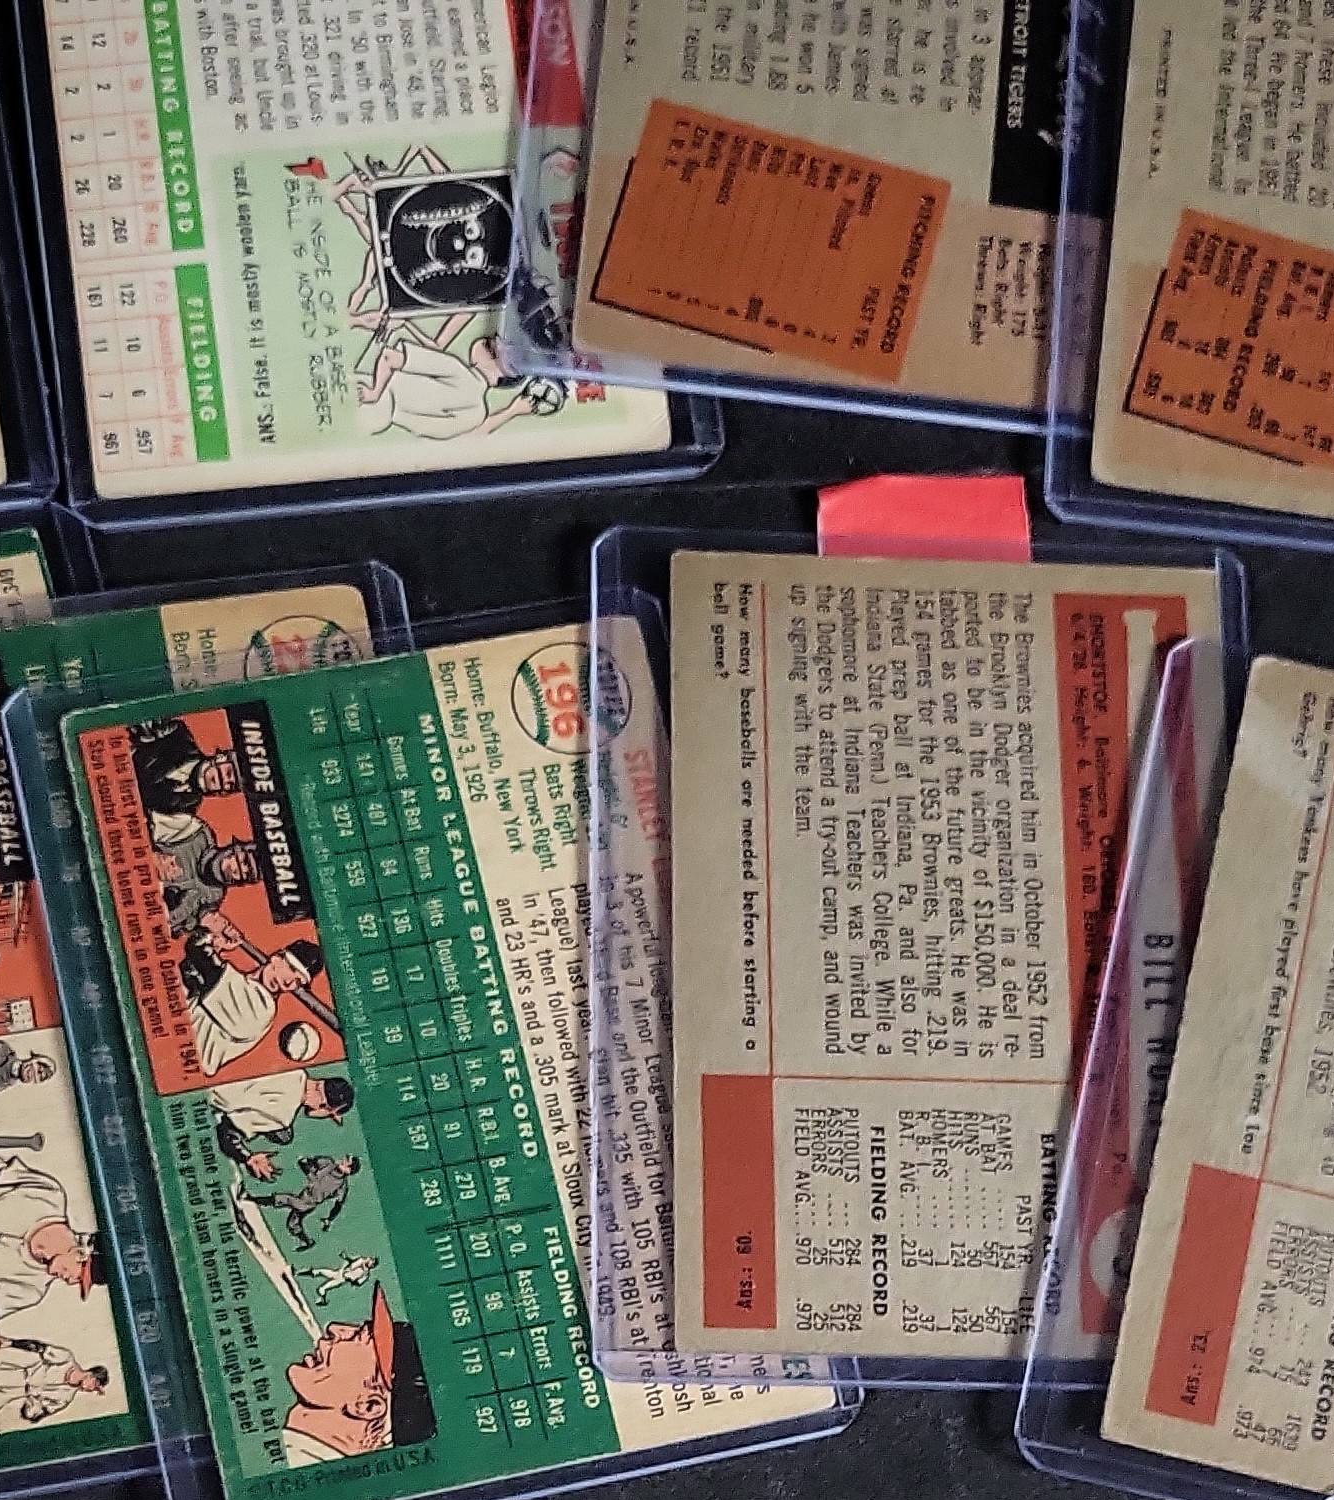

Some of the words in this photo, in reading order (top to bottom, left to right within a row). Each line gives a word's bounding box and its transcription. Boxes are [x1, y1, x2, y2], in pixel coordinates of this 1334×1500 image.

[167, 129, 195, 233] RECORD
[186, 295, 215, 425] FIELDING
[738, 584, 752, 620] How
[464, 657, 485, 707] Home:
[736, 627, 752, 678] many
[438, 661, 458, 704] Born:
[449, 708, 469, 739] May
[463, 764, 488, 802] 1926
[537, 661, 587, 739] 196
[739, 689, 758, 768] baseballs
[476, 711, 504, 774] Buffalo,
[241, 720, 267, 794] INSIDE
[262, 804, 302, 905] BASEBALL
[494, 778, 512, 812] New
[741, 779, 754, 807] are
[499, 818, 523, 854] York
[742, 819, 758, 880] needed
[419, 714, 452, 801] MINOR
[441, 814, 476, 912] LEAGUE
[472, 926, 507, 1034] BATTING
[499, 1049, 538, 1159] RECORD
[743, 890, 758, 945] before
[869, 1125, 887, 1221] FIELDING
[872, 1234, 888, 1316] RECORD
